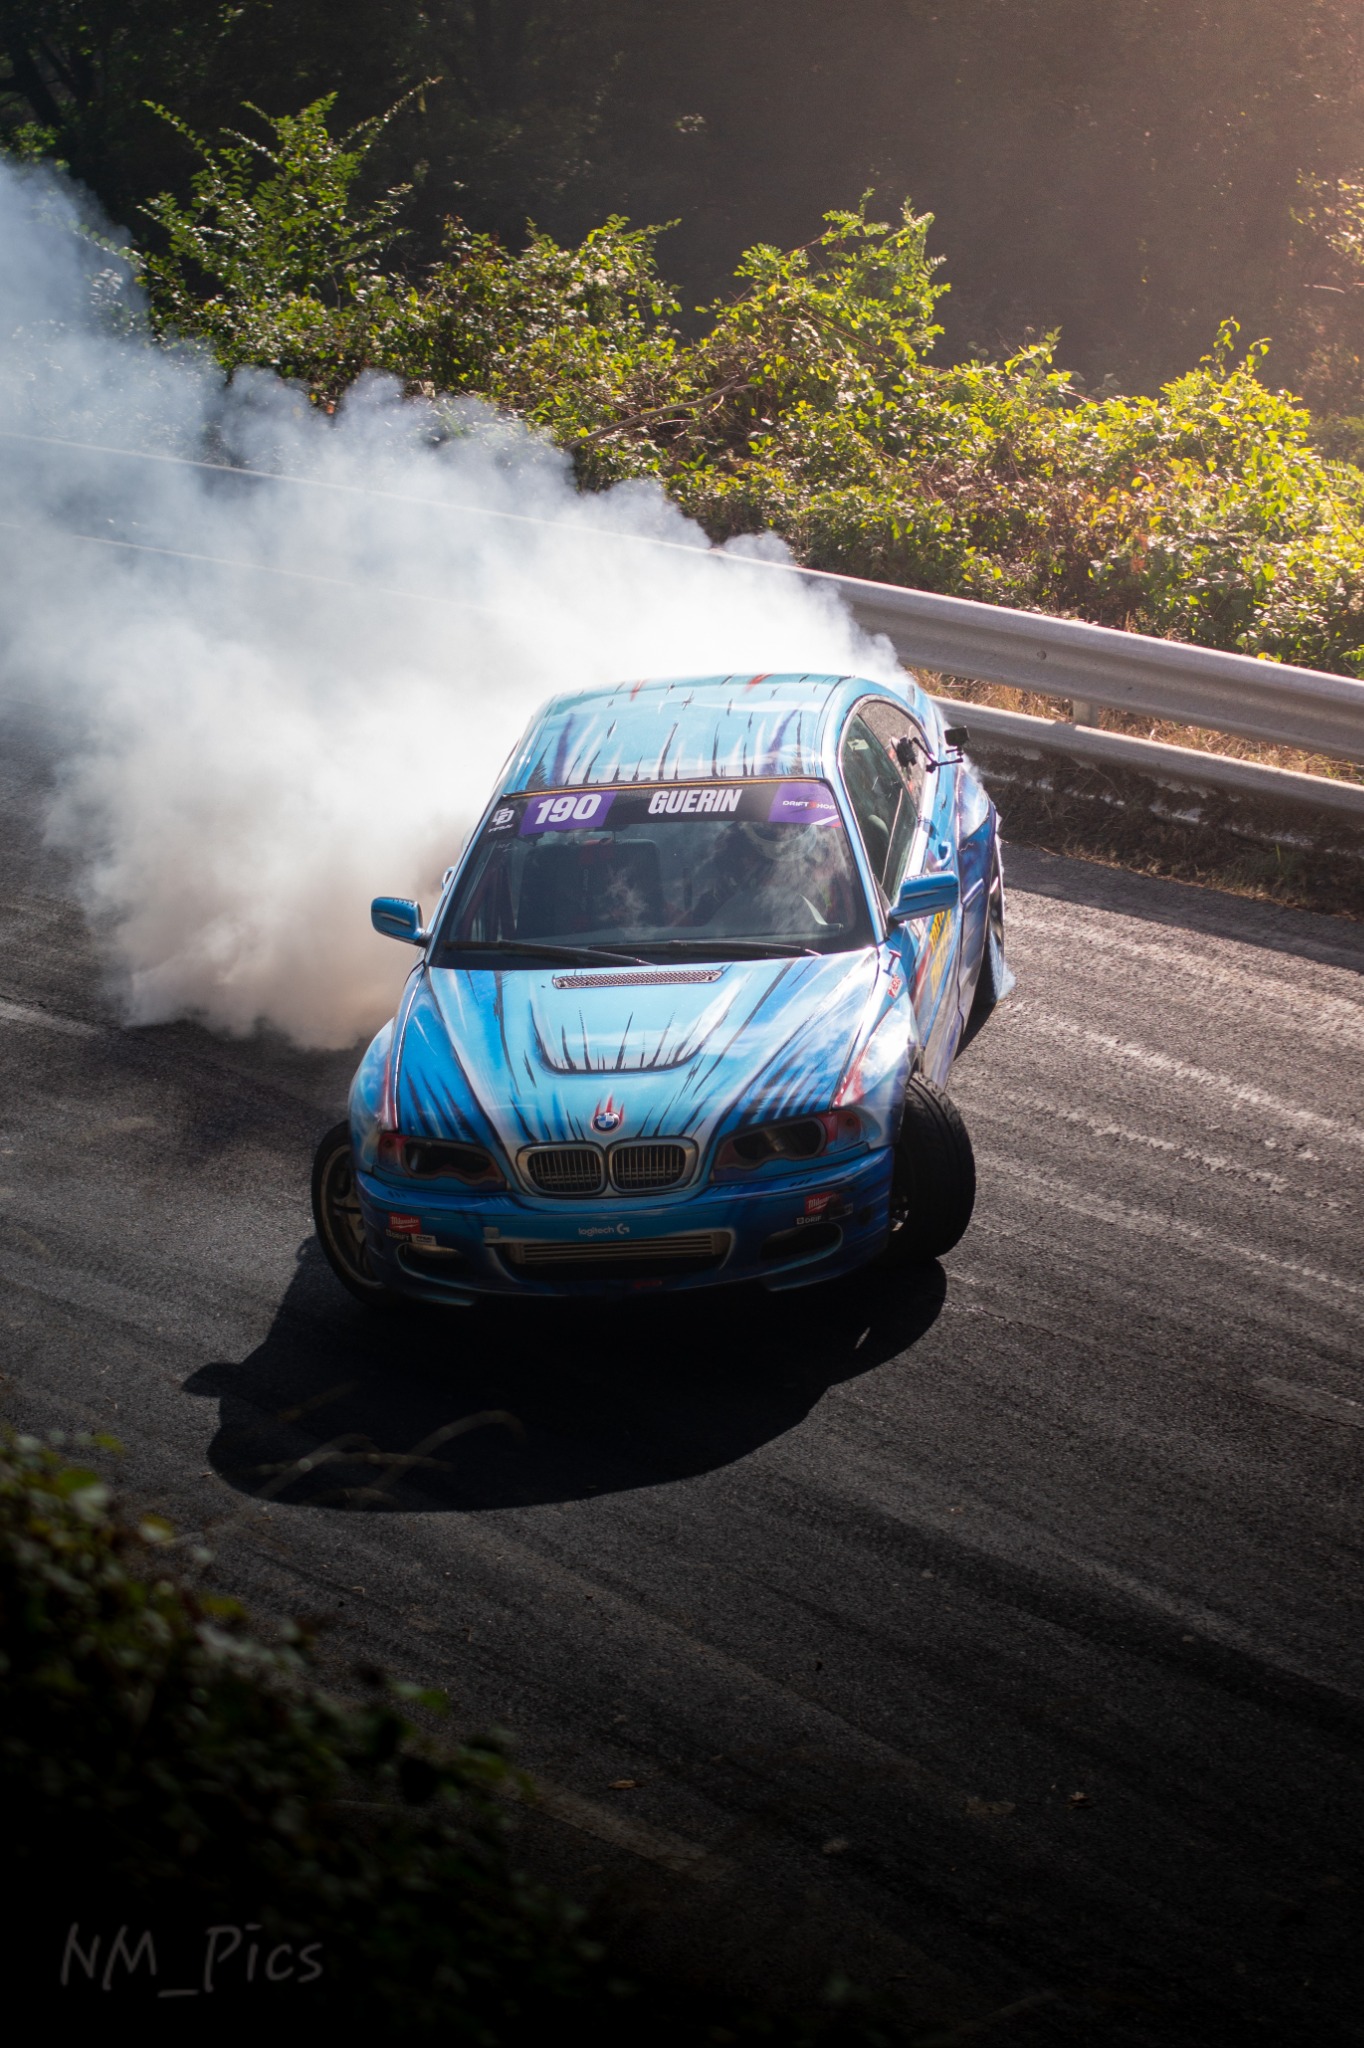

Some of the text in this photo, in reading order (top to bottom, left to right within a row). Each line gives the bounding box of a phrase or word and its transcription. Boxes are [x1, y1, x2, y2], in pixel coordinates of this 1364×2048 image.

[534, 794, 602, 825] 190
[648, 789, 743, 814] GUERIN
[578, 1225, 615, 1237] logitech
